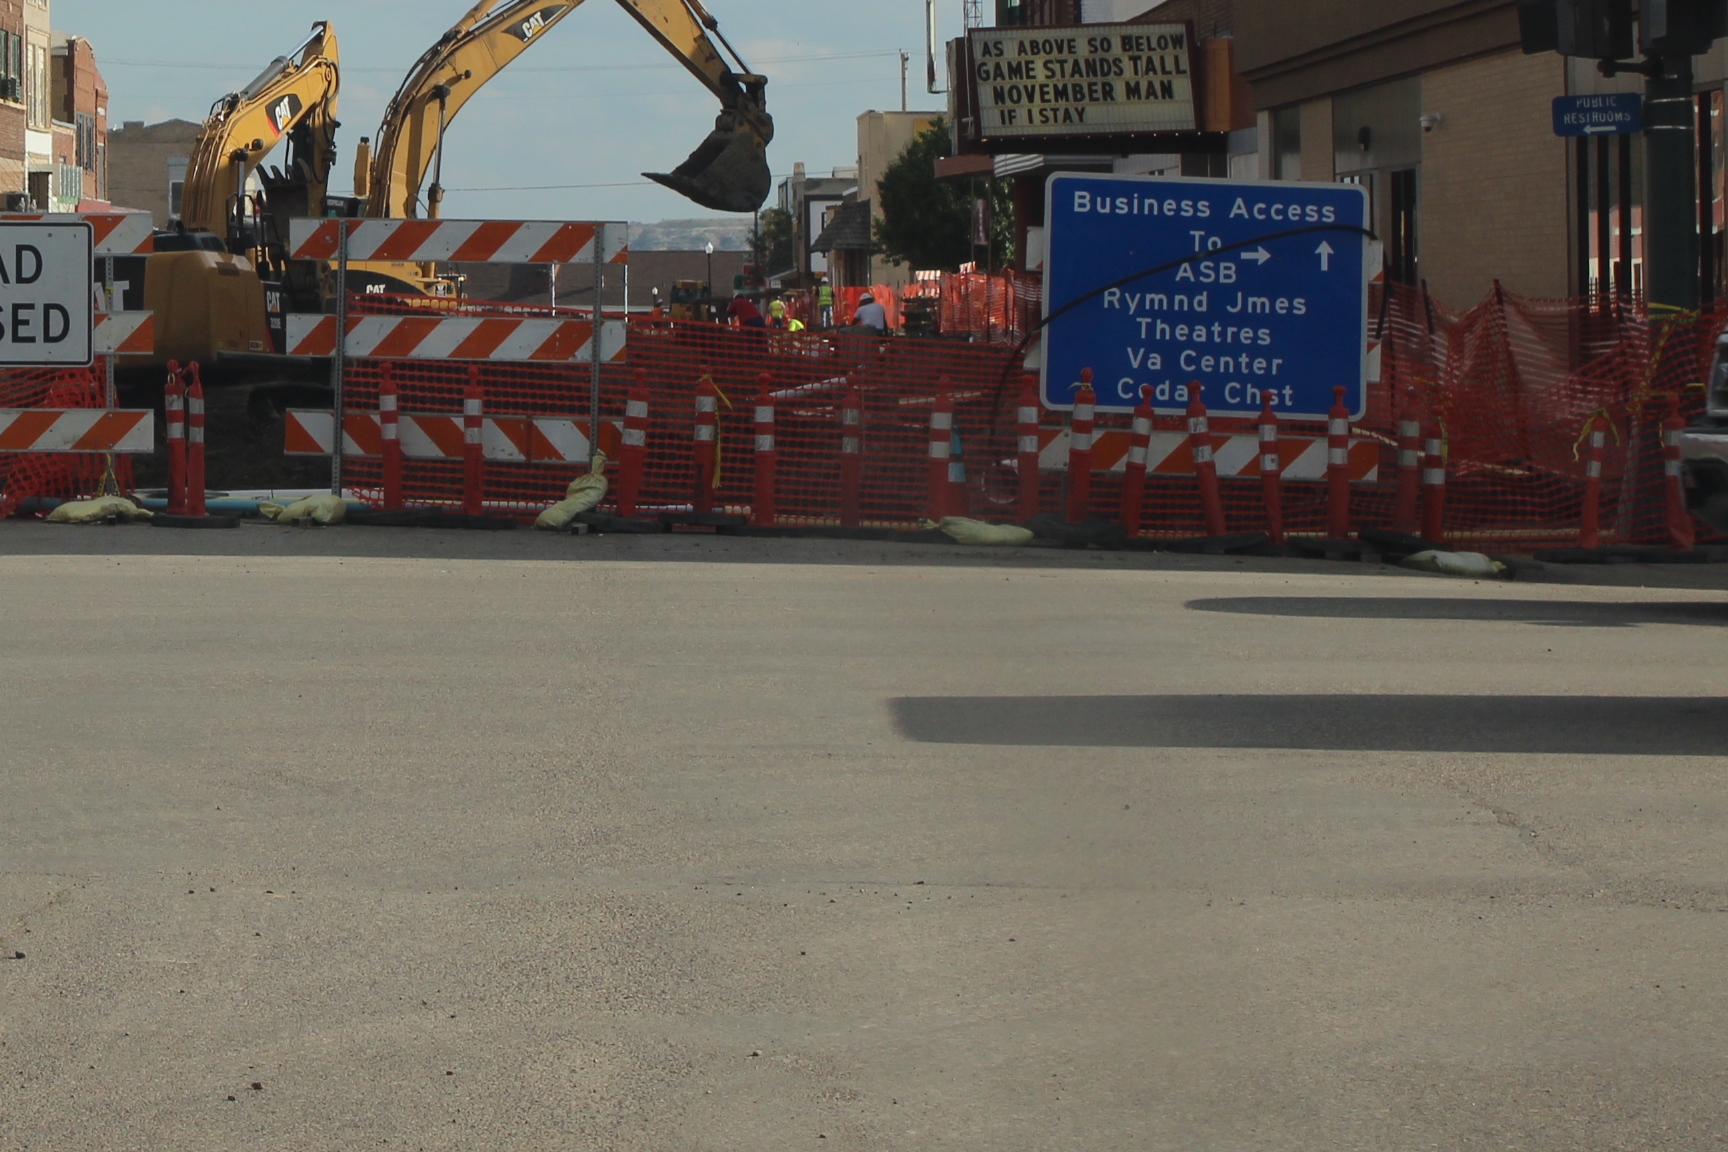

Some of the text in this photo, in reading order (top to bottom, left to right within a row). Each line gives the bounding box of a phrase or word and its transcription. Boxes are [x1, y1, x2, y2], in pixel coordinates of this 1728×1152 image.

[521, 11, 546, 38] CAT
[982, 34, 1184, 57] AS ABOVE SO BELOW
[977, 55, 1187, 81] GAME STANDS TALL
[993, 80, 1174, 105] NOVEMBER MAN
[1576, 96, 1617, 108] PUBLIC
[274, 95, 292, 132] CAT
[1001, 107, 1086, 125] IF I STAY
[1563, 111, 1632, 125] RESTROOMS
[1073, 190, 1336, 222] Business Access
[1190, 230, 1222, 252] To
[1175, 261, 1237, 284] ASB
[266, 290, 281, 313] CAT
[1103, 287, 1307, 315] Rymnd Jmes
[1136, 317, 1272, 345] Theatres
[1127, 347, 1283, 375] Va Center
[1117, 377, 1206, 402] Cda
